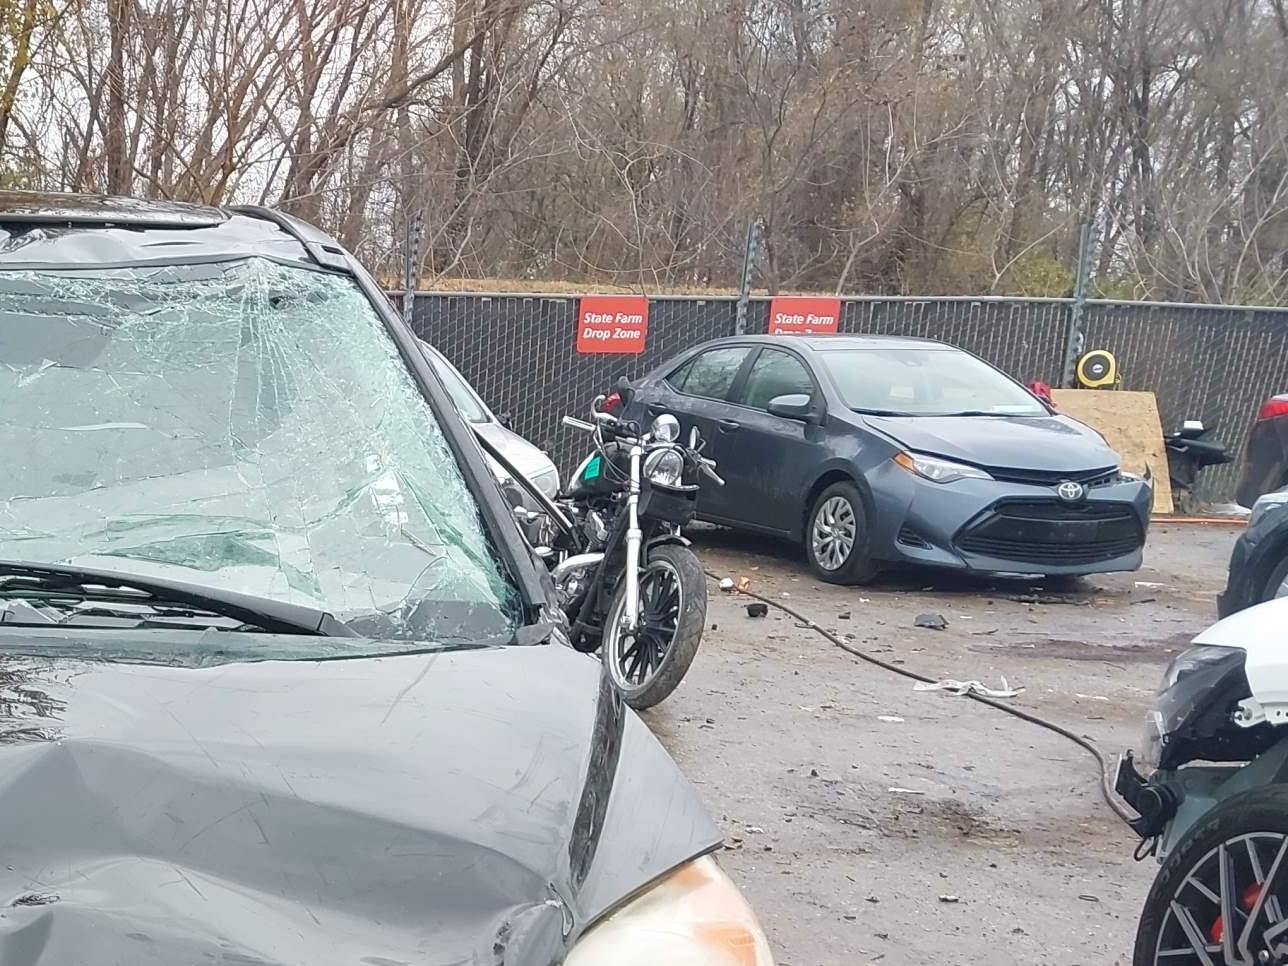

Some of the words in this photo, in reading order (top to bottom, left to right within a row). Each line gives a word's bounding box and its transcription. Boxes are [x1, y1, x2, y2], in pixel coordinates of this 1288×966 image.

[583, 312, 613, 324] State
[615, 313, 642, 324] Farm
[774, 313, 804, 324] State
[806, 313, 834, 325] Farm
[583, 328, 611, 341] Drop
[613, 328, 641, 339] Zone
